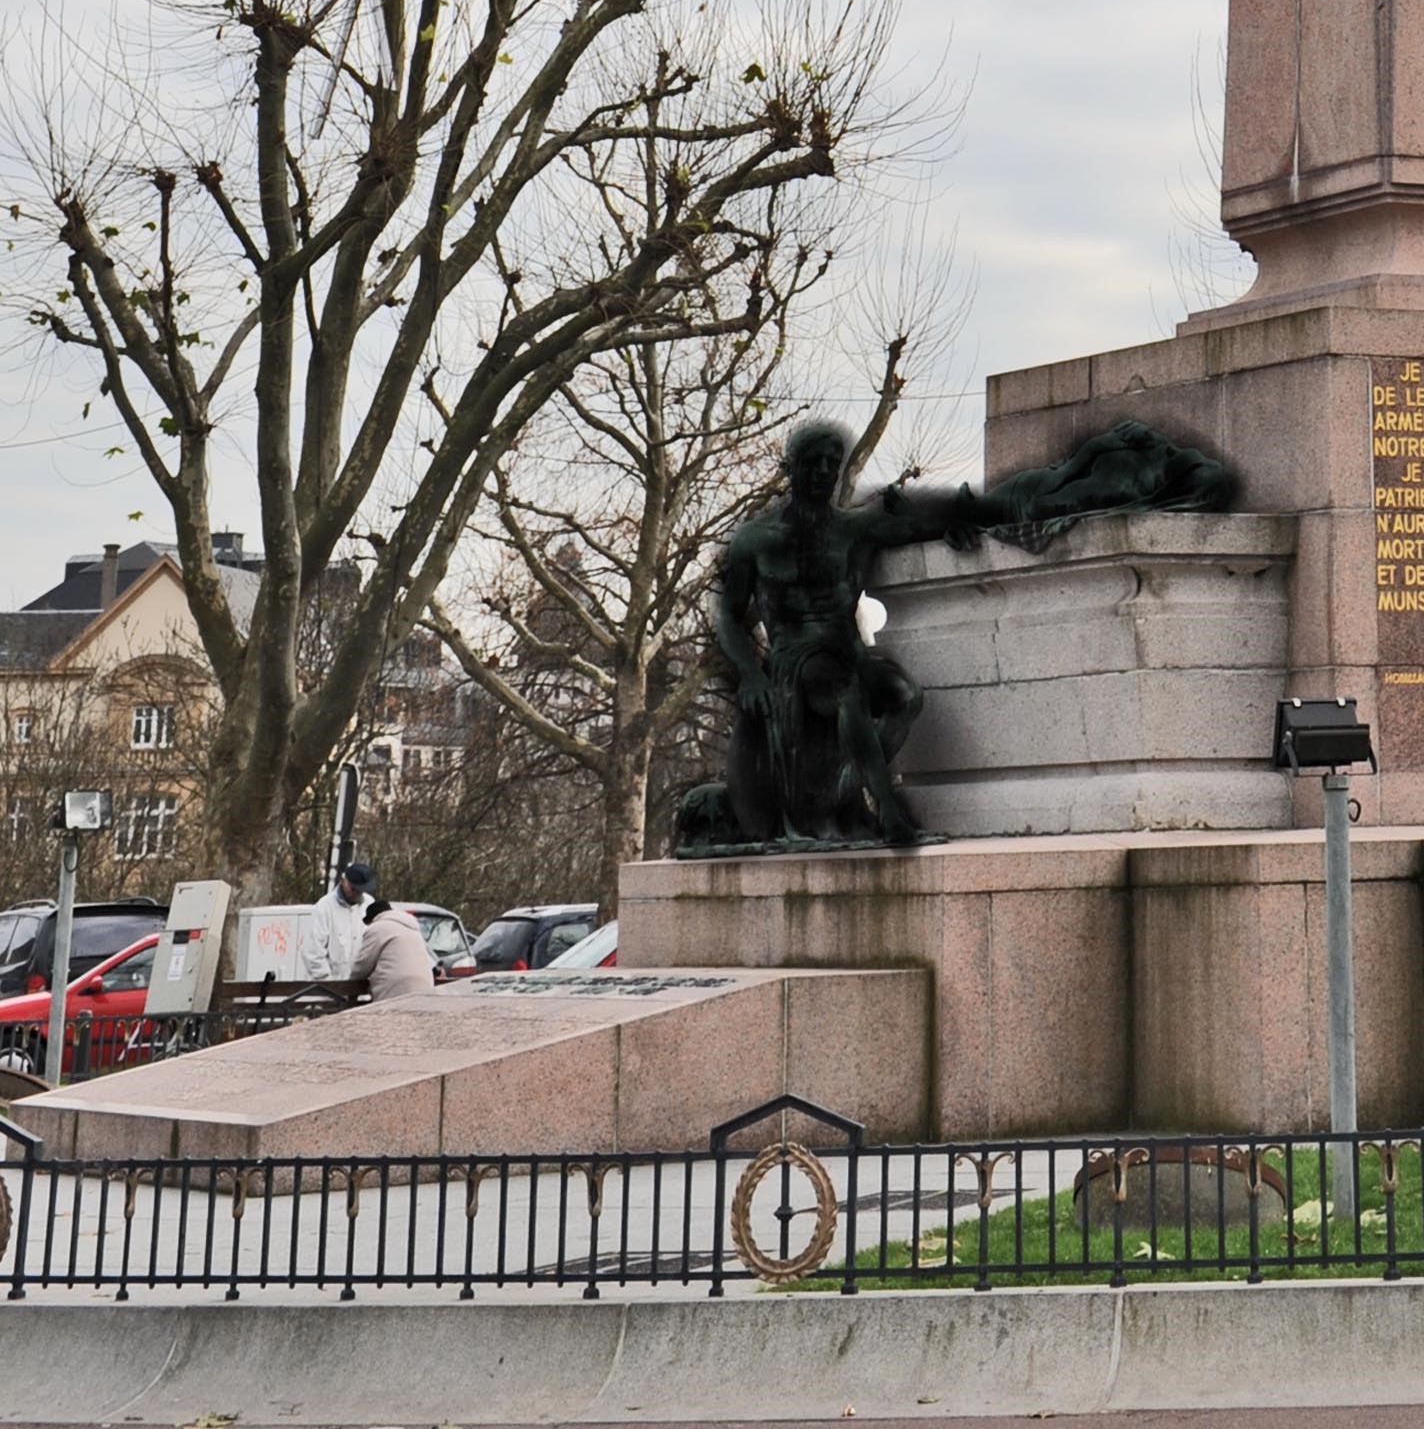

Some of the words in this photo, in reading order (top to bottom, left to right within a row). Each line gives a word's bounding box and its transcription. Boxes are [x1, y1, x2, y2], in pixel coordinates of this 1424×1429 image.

[1399, 364, 1421, 382] JE
[1372, 388, 1395, 405] DE
[1400, 465, 1421, 482] JE
[1376, 541, 1424, 559] MORT
[1375, 567, 1396, 585] ET
